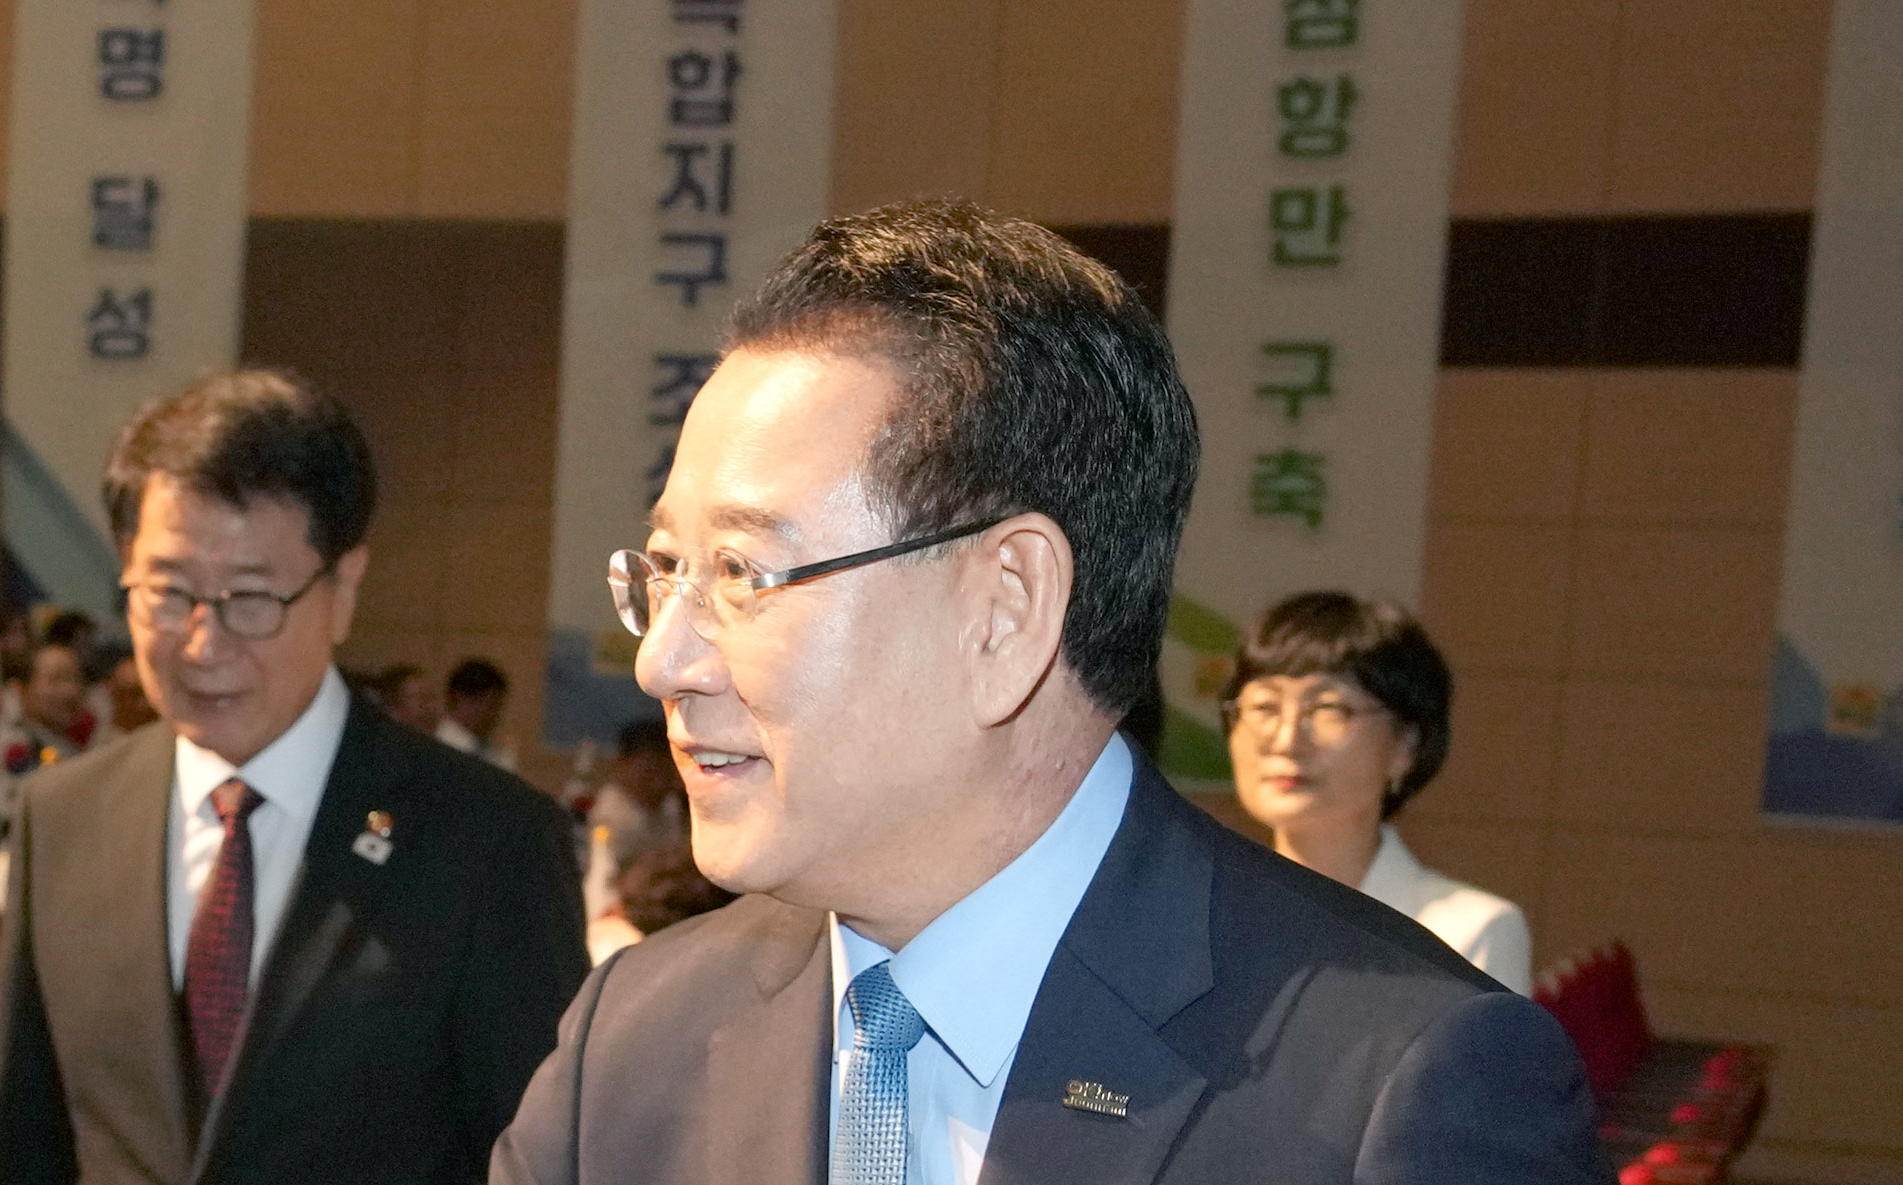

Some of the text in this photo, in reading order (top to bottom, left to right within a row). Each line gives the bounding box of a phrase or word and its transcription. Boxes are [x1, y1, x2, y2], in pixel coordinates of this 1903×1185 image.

[88, 0, 166, 361] 명 달성
[1251, 340, 1334, 530] 구축
